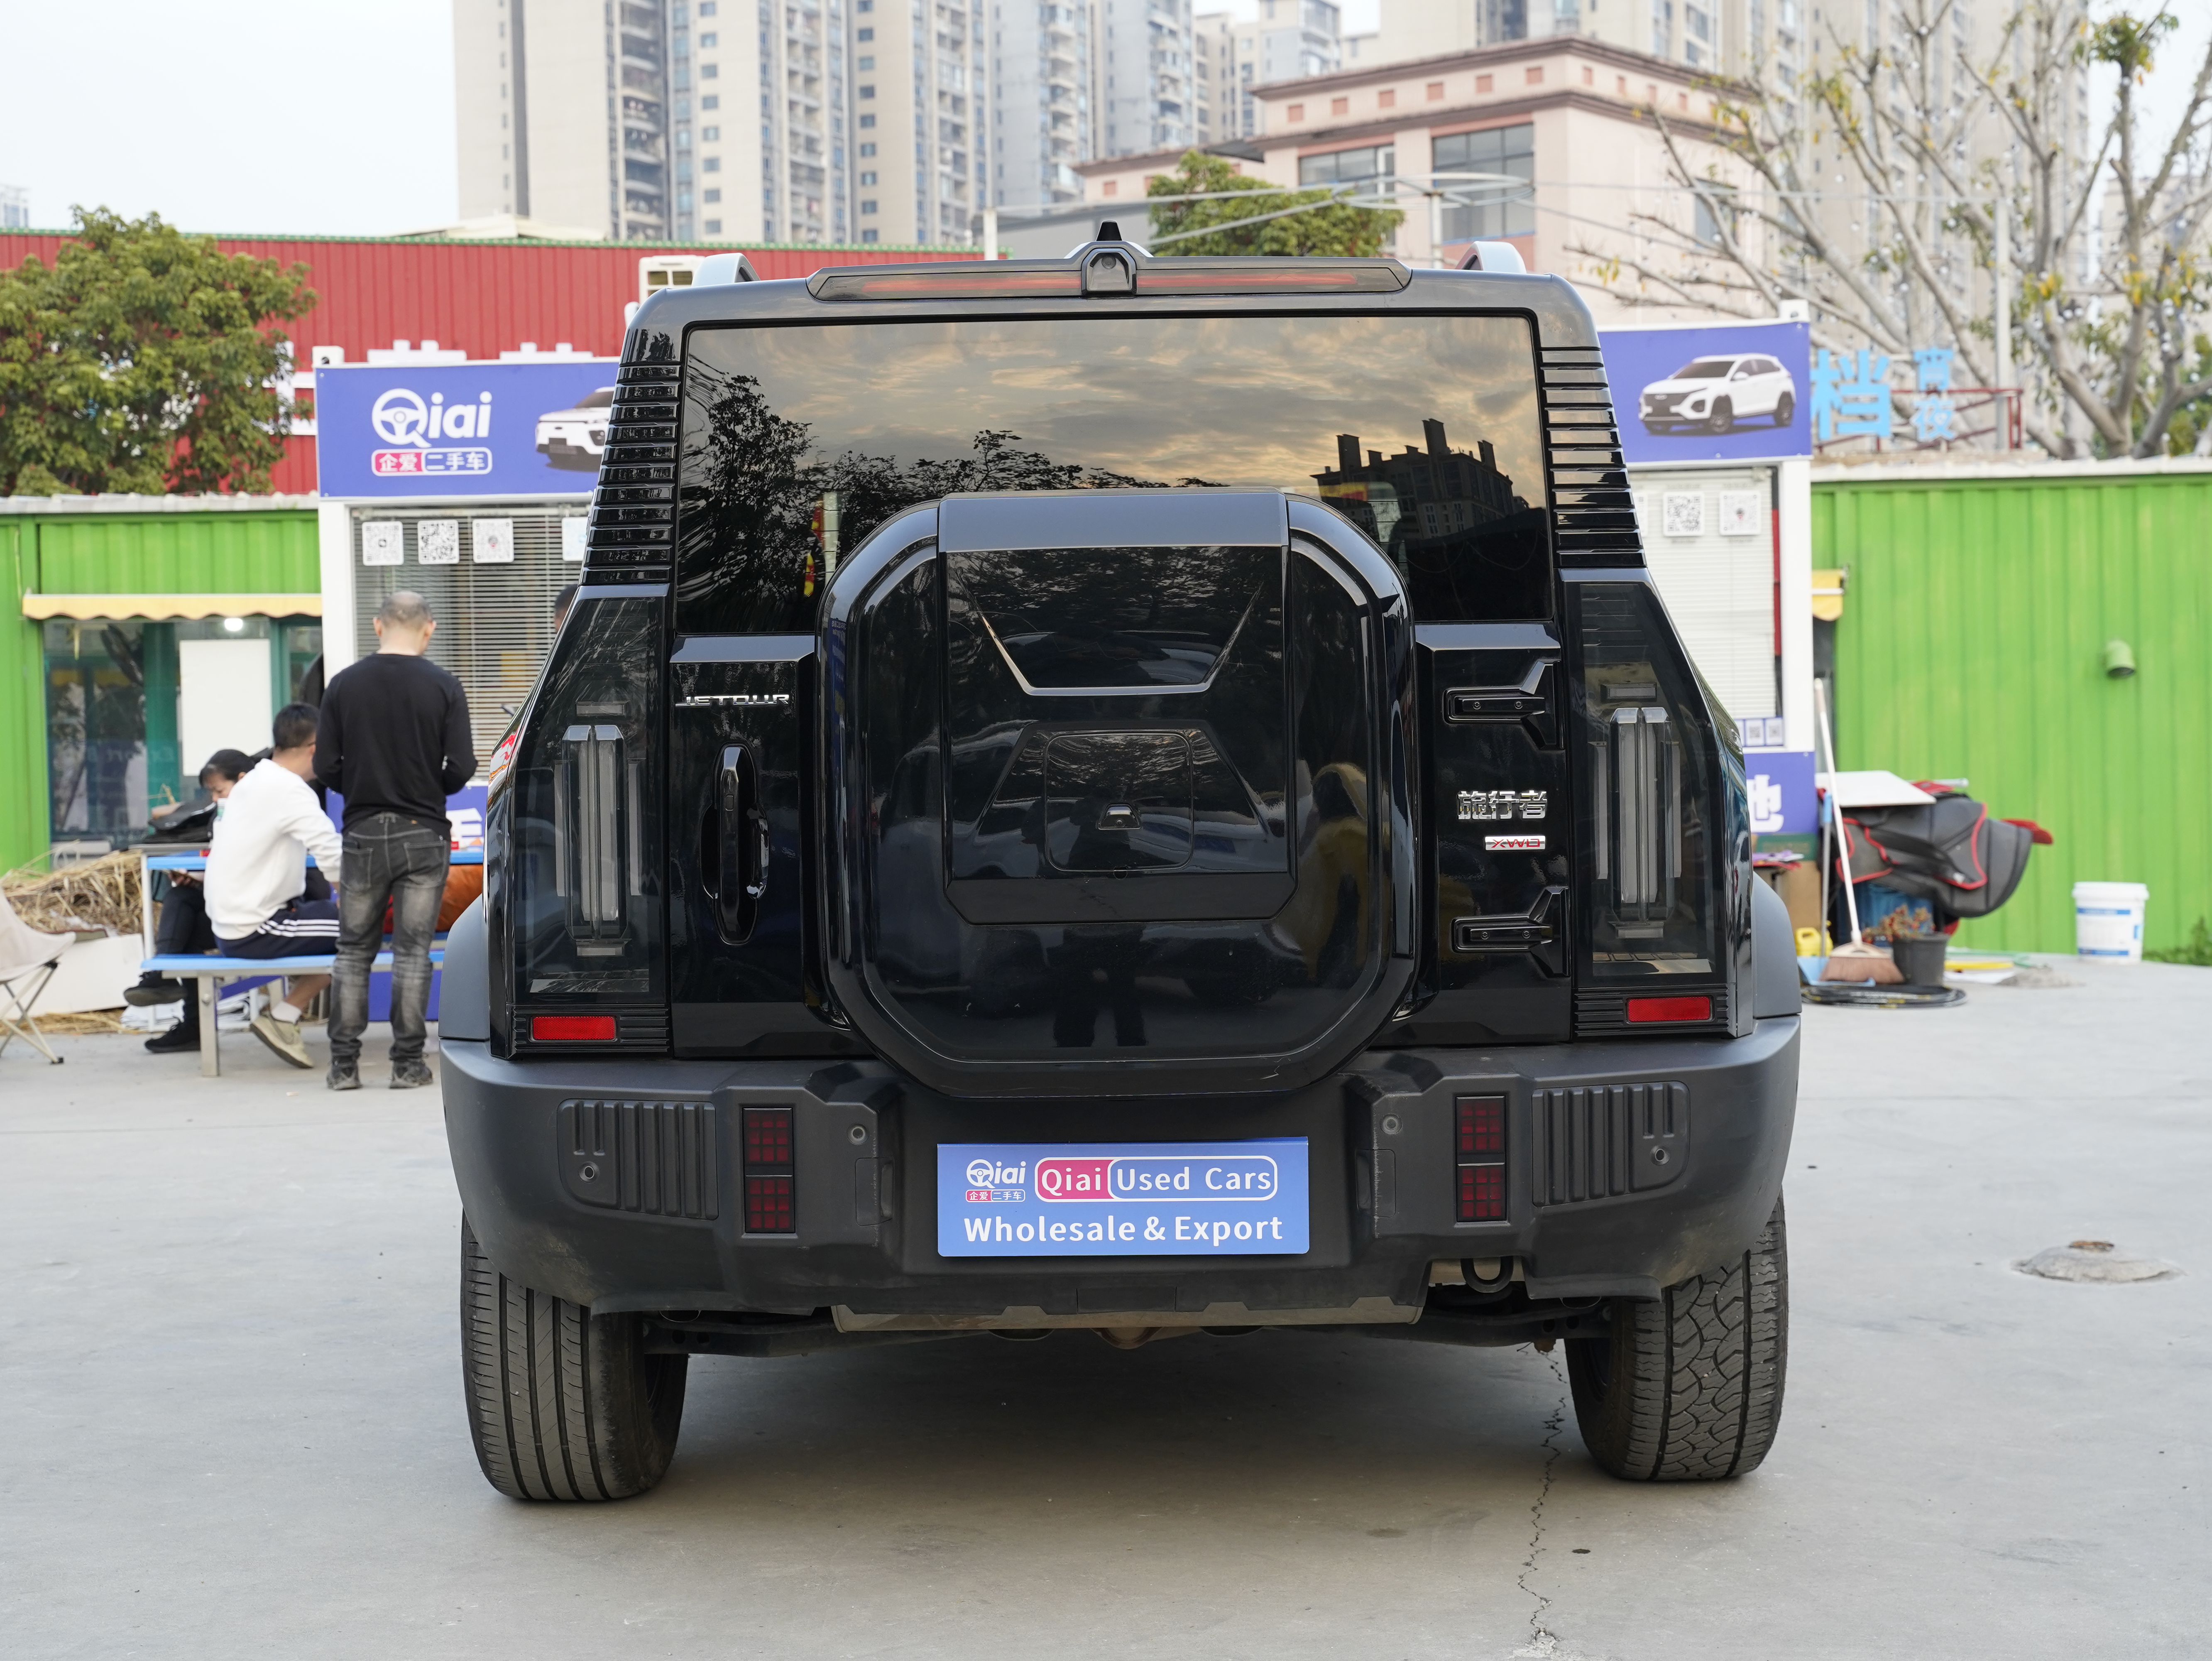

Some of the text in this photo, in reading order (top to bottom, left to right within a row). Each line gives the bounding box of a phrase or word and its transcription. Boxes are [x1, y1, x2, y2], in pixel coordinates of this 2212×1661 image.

[1809, 349, 1891, 441] 档
[371, 388, 492, 448] Qiai
[675, 694, 789, 707] JETOUR
[1457, 790, 1548, 820] 旅行者
[1491, 838, 1540, 848] XWD
[966, 1159, 1026, 1189] Qiai
[1041, 1166, 1271, 1196] Qiai Used Cars
[964, 1215, 1283, 1247] Wholesale & Export
